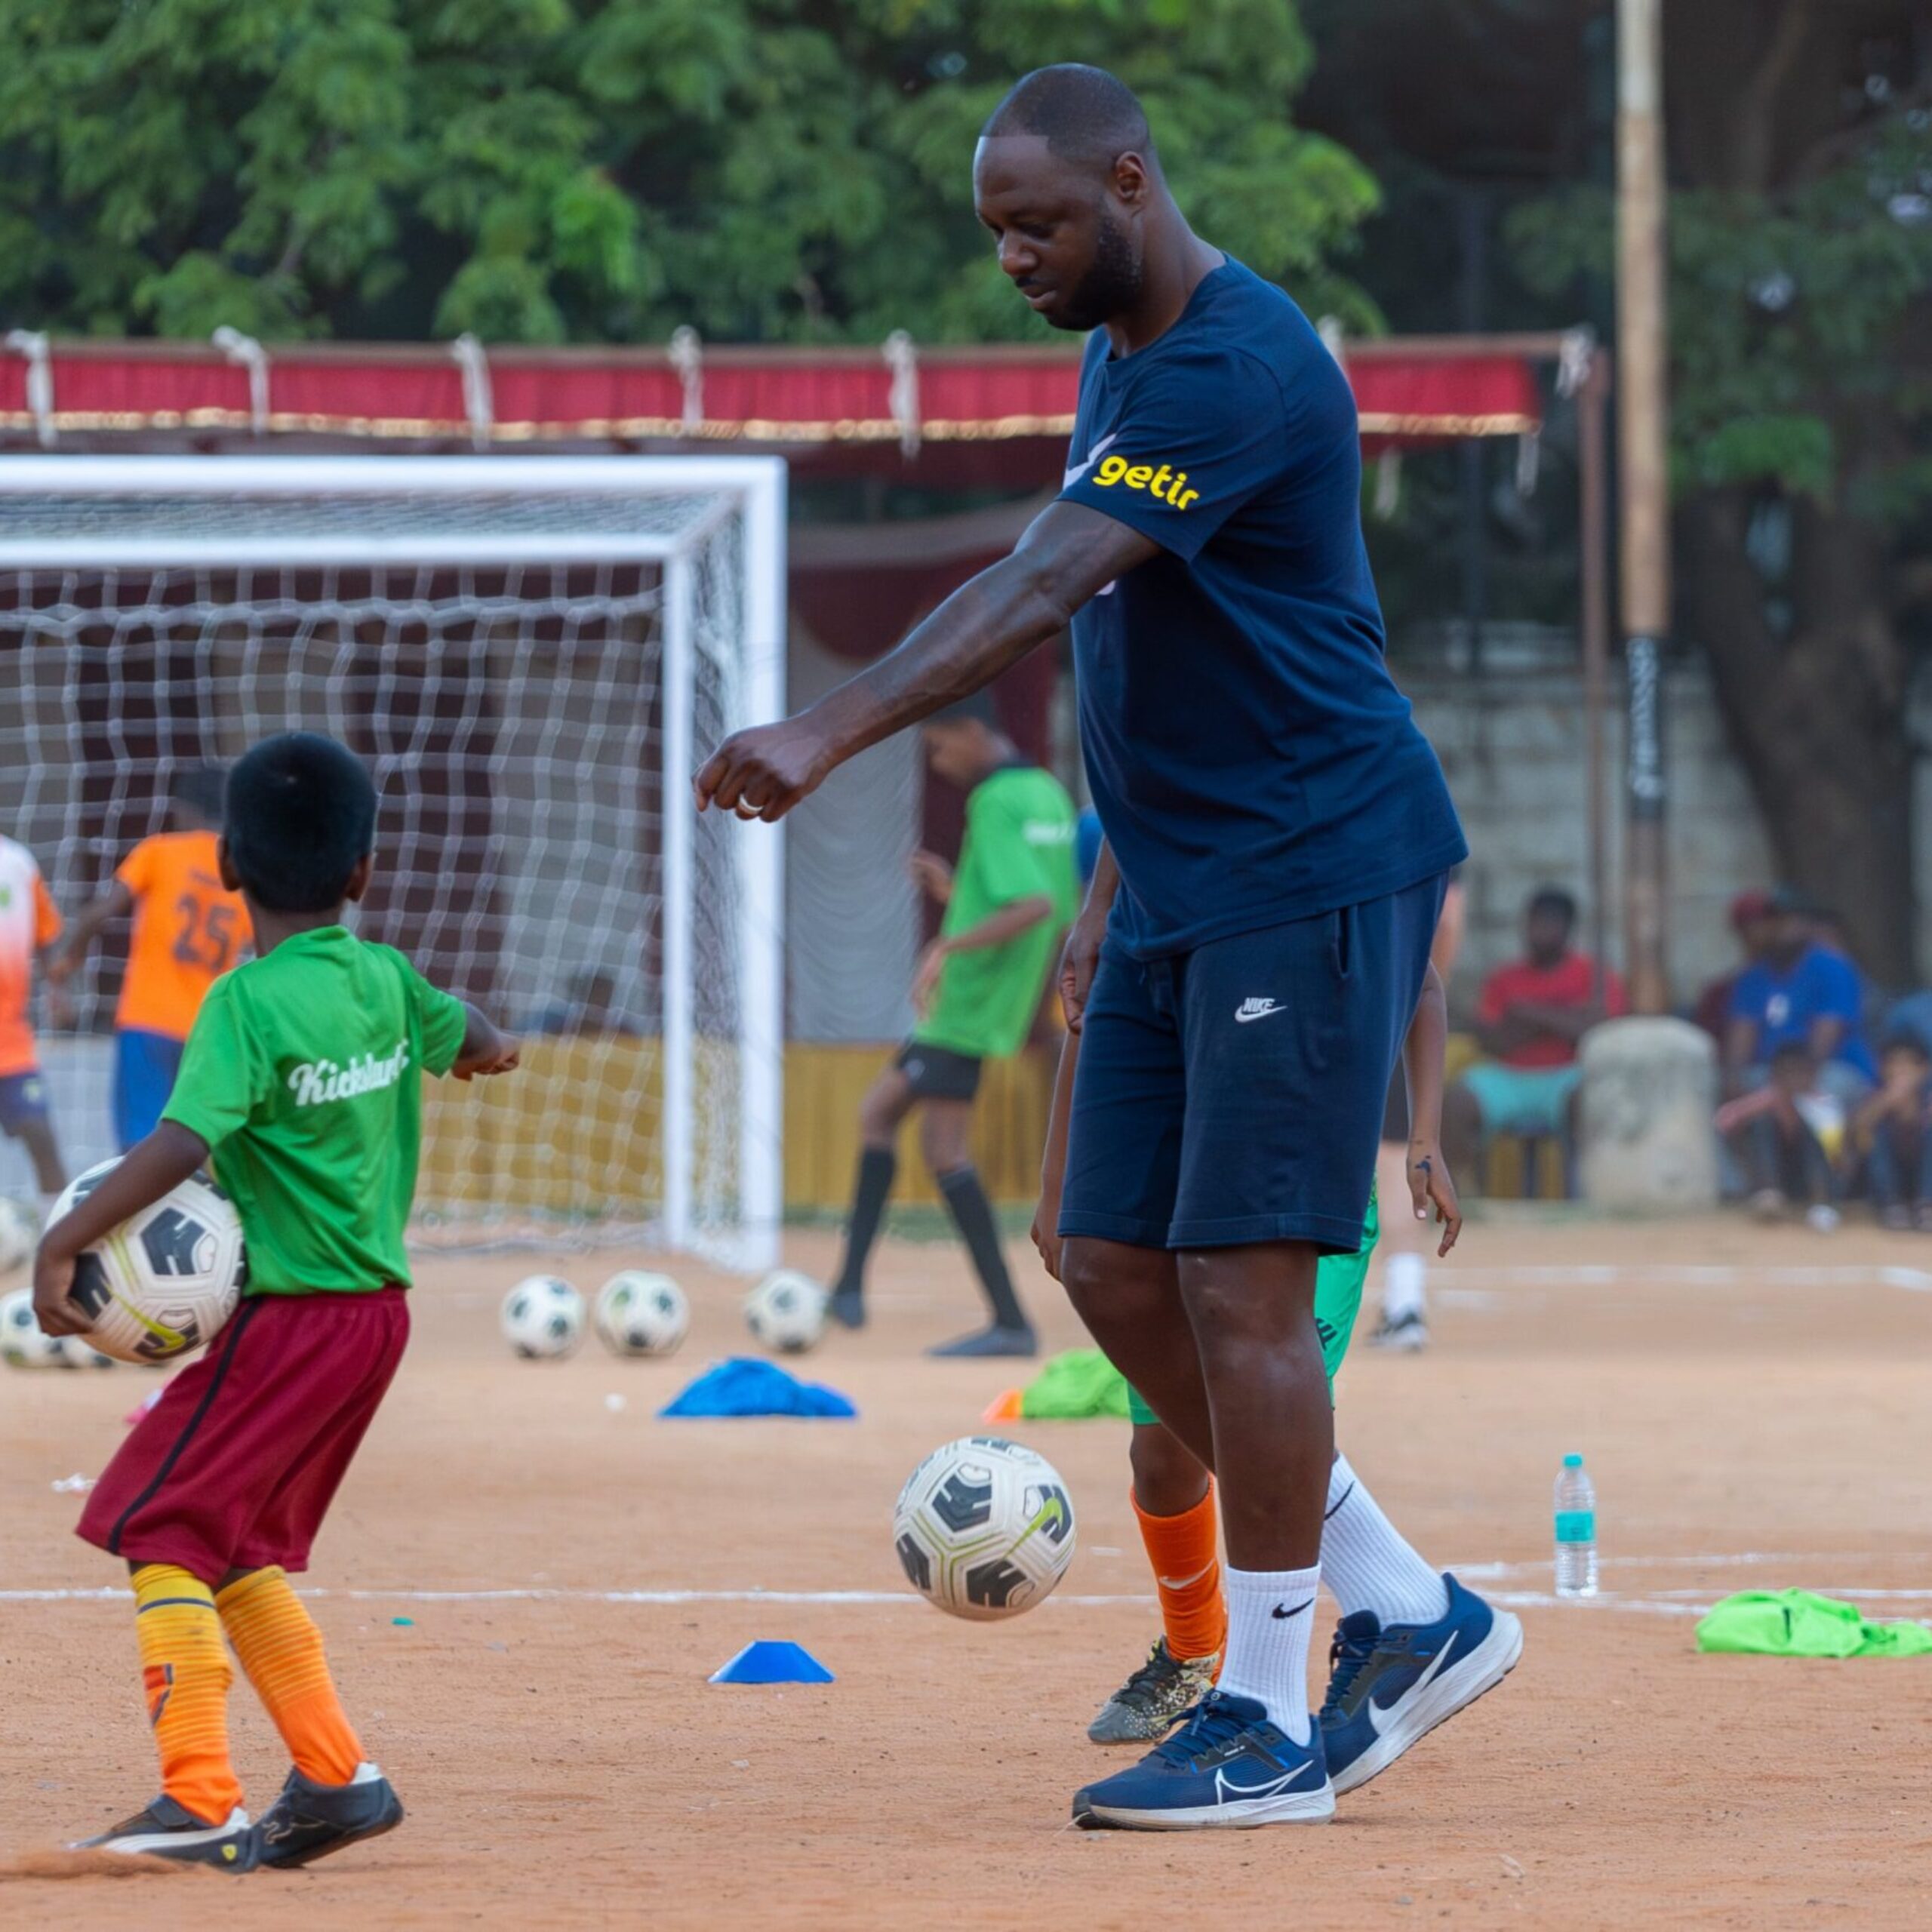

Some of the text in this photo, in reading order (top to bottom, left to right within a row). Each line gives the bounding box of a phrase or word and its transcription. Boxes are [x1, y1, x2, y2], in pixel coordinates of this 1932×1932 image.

[1092, 455, 1199, 510] getir
[173, 893, 236, 973] 25
[1243, 997, 1275, 1012] NIKE
